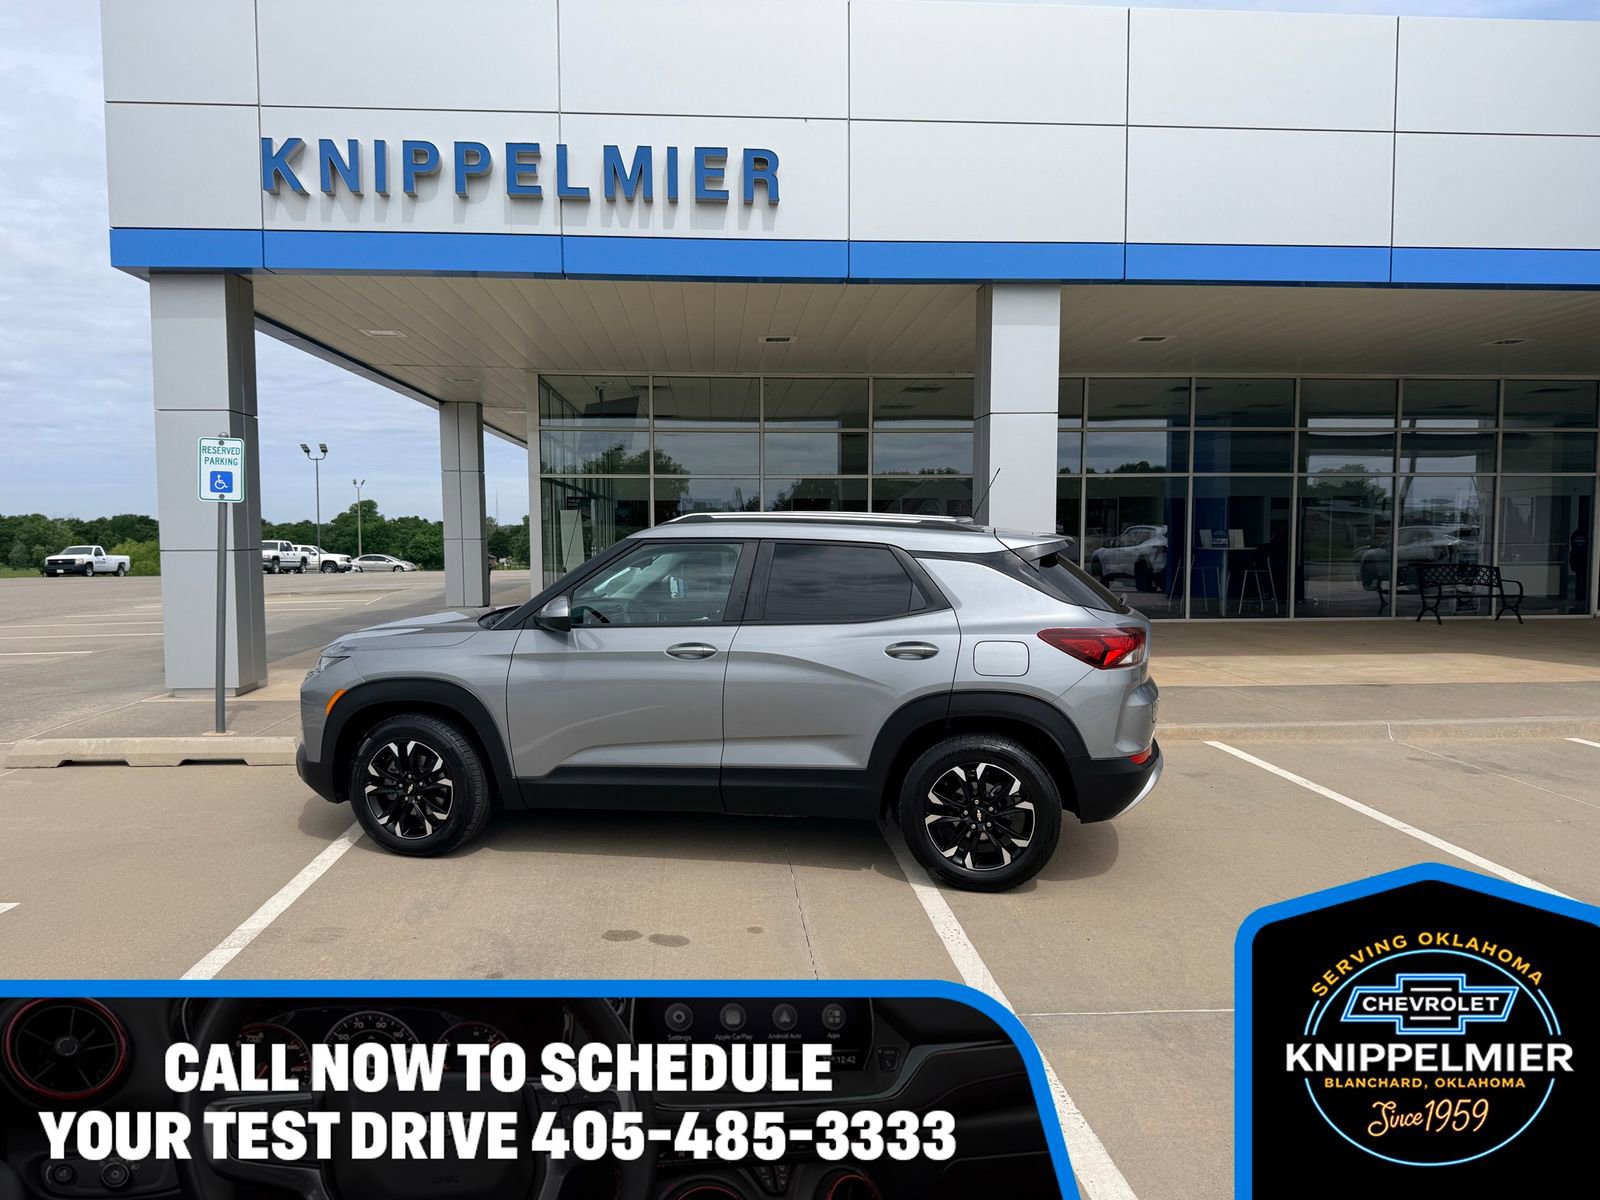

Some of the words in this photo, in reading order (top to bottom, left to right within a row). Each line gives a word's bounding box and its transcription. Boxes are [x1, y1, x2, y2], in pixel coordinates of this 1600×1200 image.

[261, 138, 780, 204] KNIPPELMIER
[202, 446, 241, 455] RESERVED
[204, 457, 239, 466] PARKING
